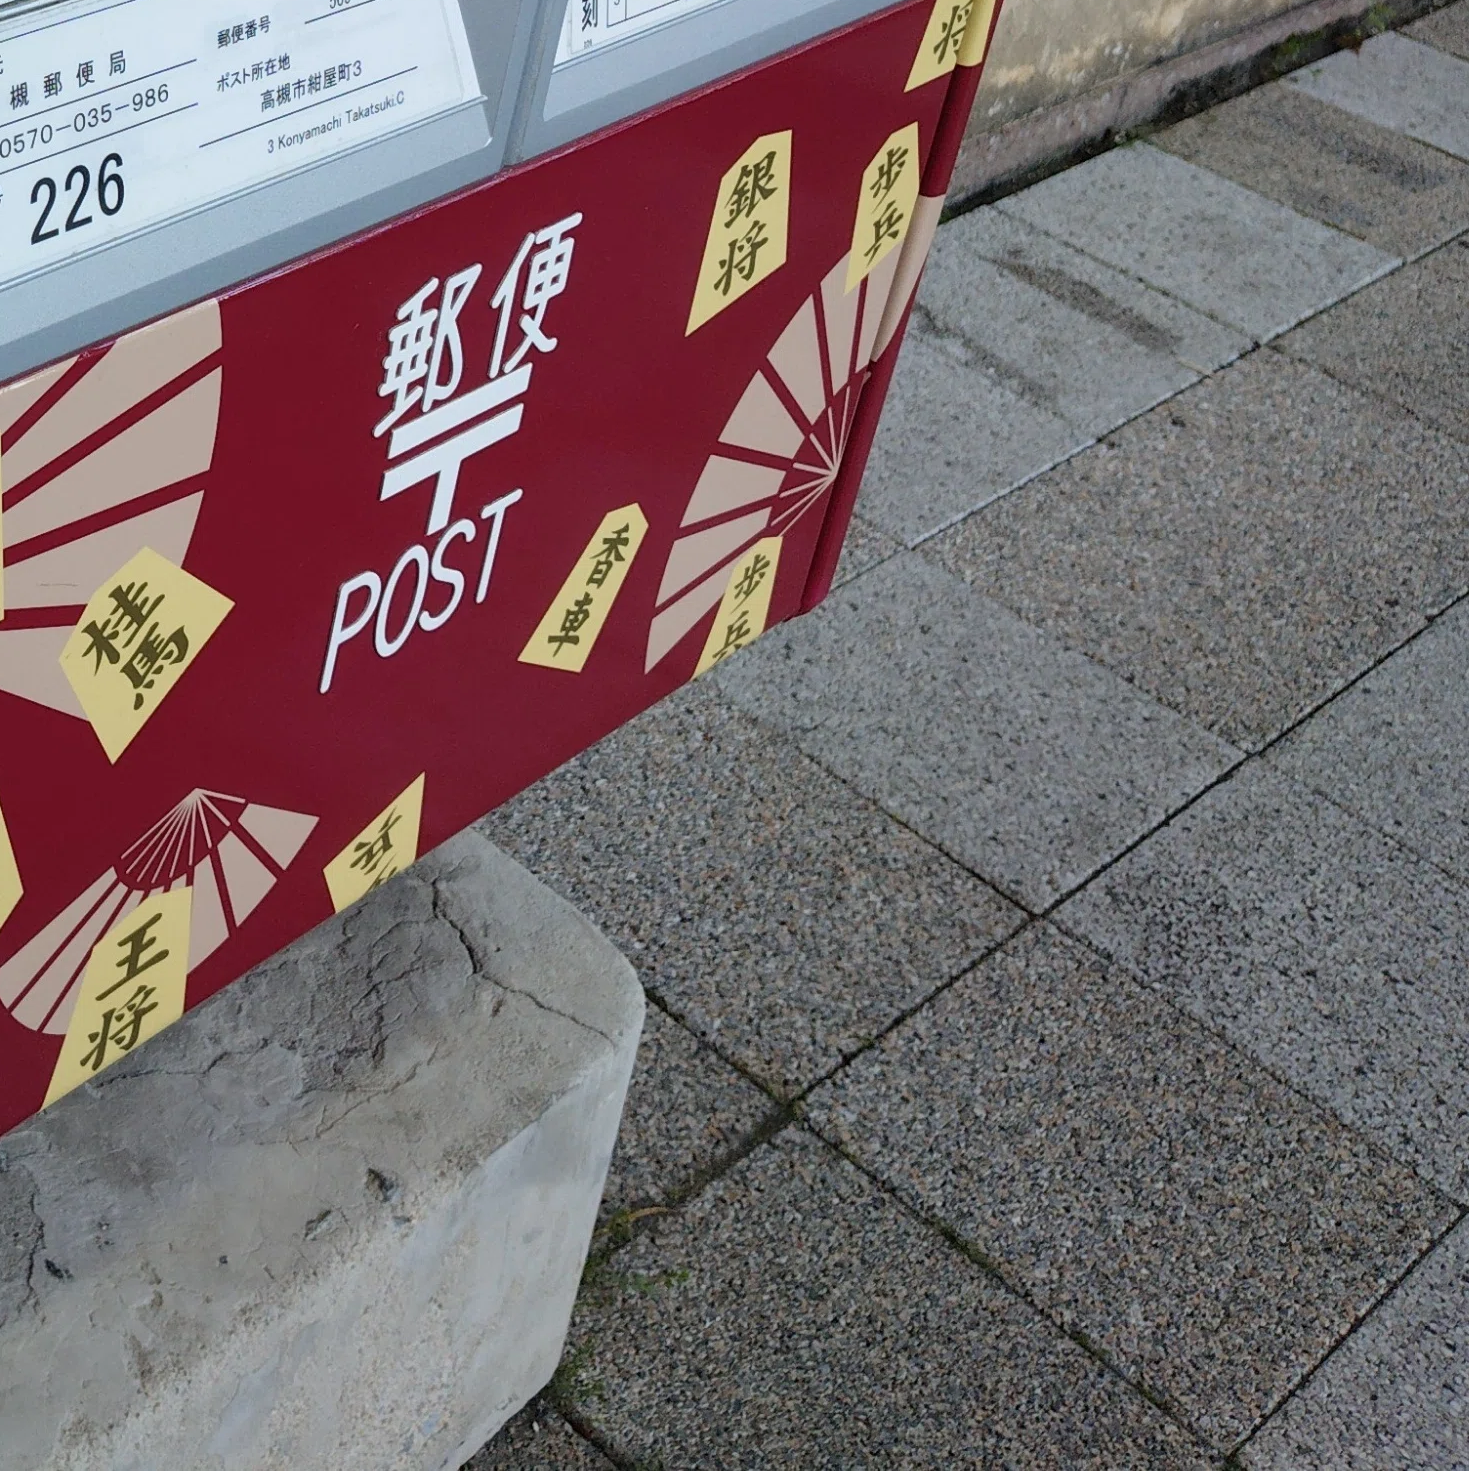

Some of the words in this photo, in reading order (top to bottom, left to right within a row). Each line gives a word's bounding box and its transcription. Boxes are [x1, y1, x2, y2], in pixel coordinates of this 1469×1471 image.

[216, 53, 290, 93] ポスト所在地
[217, 15, 271, 48] 郵便番号
[260, 60, 362, 113] 高槻市紺屋町3
[267, 139, 275, 154] 3
[278, 117, 342, 150] Konyamachi
[29, 152, 125, 245] 226
[712, 150, 777, 296] 銀将
[864, 145, 909, 267] 歩兵
[374, 212, 583, 438] 郵便
[81, 581, 190, 712] 桂馬
[319, 489, 523, 694] POST
[547, 522, 630, 658] 香車
[712, 553, 771, 661] 歩兵
[80, 912, 170, 1072] 王将
